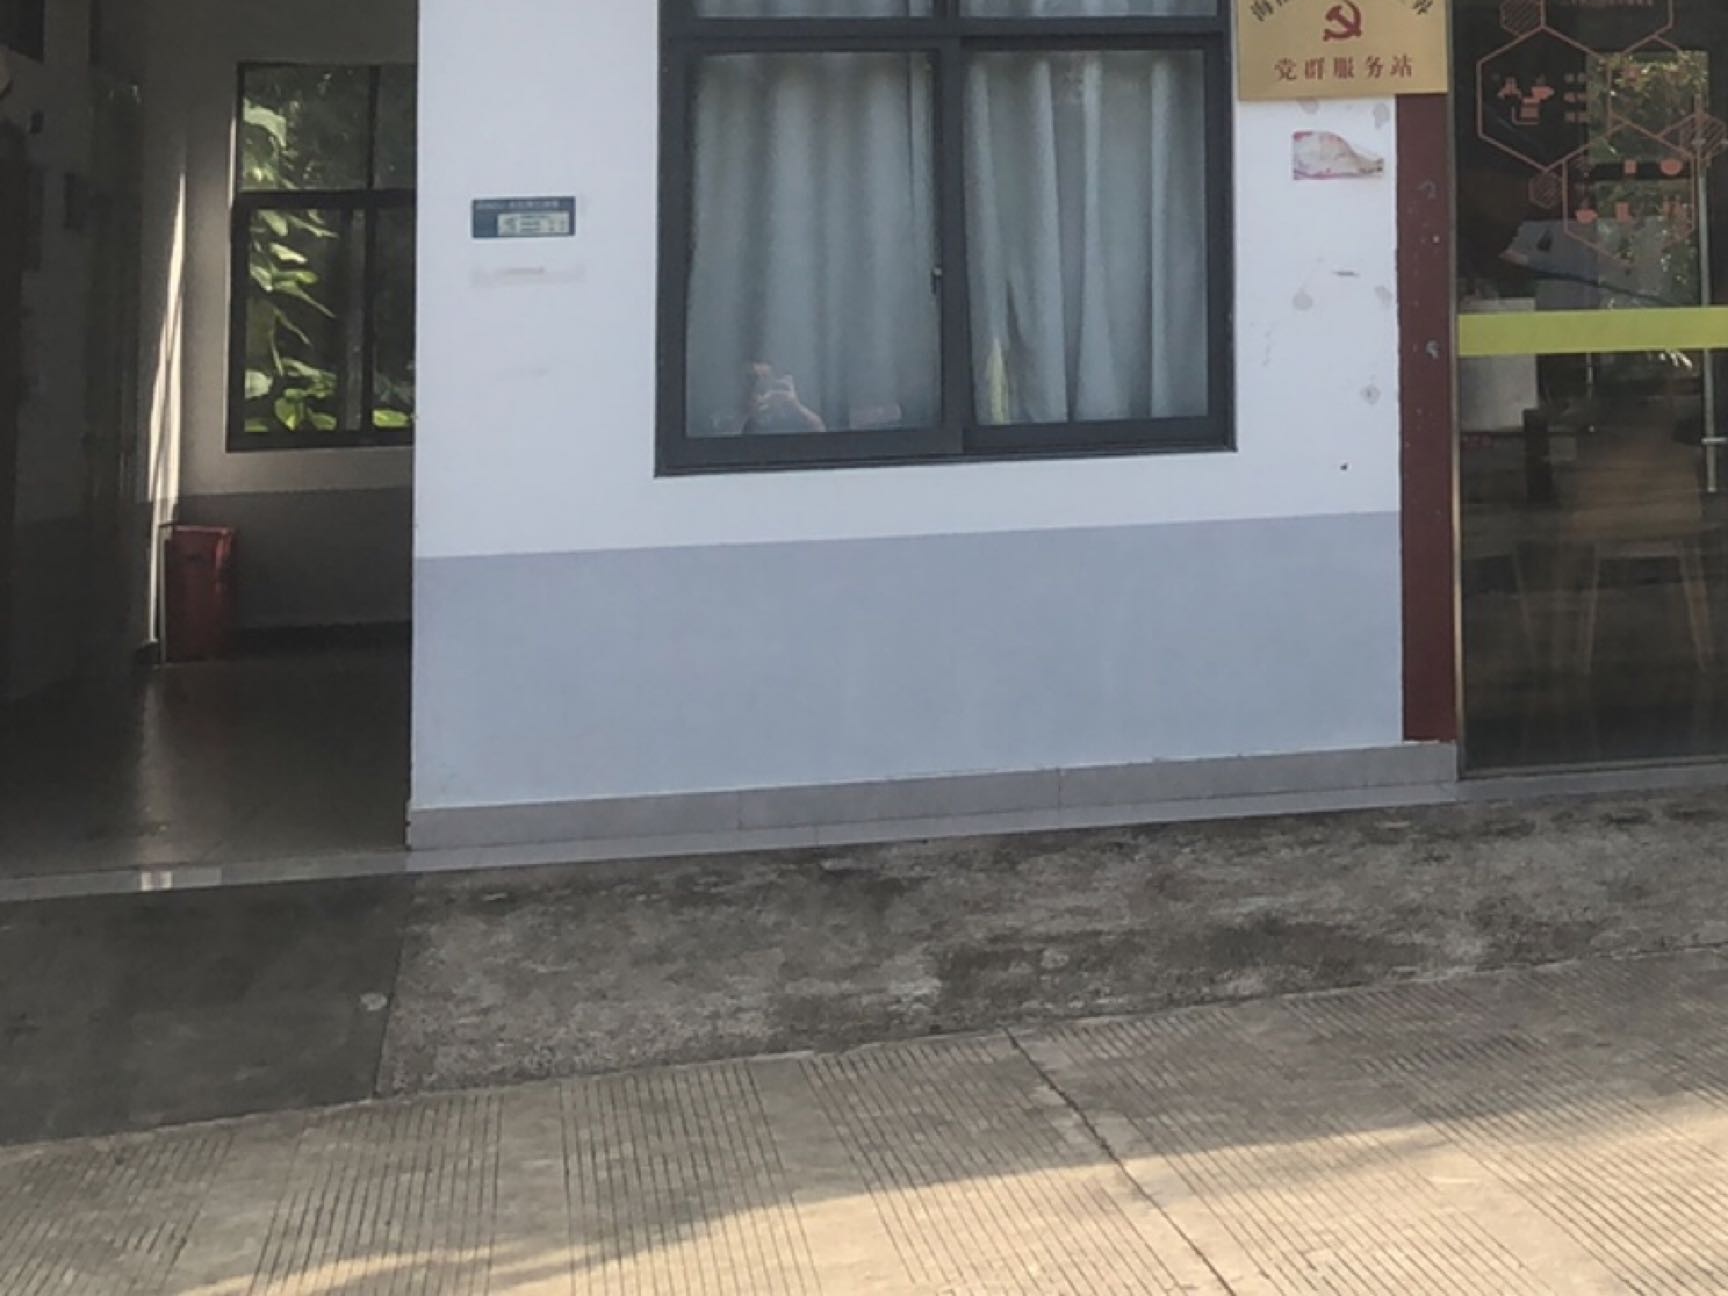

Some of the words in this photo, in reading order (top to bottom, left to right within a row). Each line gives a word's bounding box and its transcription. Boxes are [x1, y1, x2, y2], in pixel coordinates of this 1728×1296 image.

[1274, 53, 1413, 81] 党群服务站
